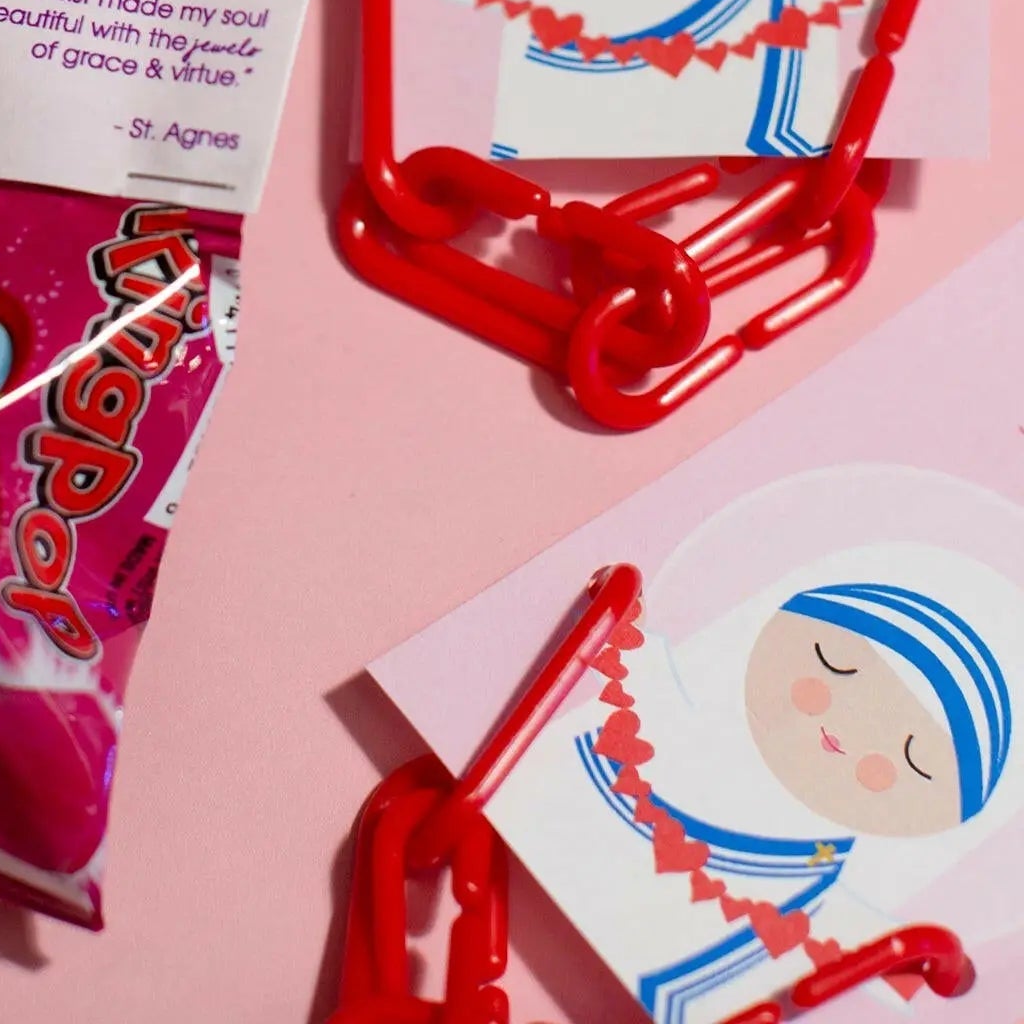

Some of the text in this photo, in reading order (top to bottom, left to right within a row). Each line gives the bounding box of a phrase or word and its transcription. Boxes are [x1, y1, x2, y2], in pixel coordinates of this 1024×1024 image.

[180, 4, 216, 28] my
[221, 8, 270, 29] soul
[91, 20, 142, 45] with
[149, 27, 188, 52] the
[181, 37, 264, 63] jewels
[31, 41, 60, 60] of
[62, 47, 138, 76] grace
[145, 58, 164, 81] &
[129, 117, 157, 141] St.
[163, 122, 241, 151] Agnes
